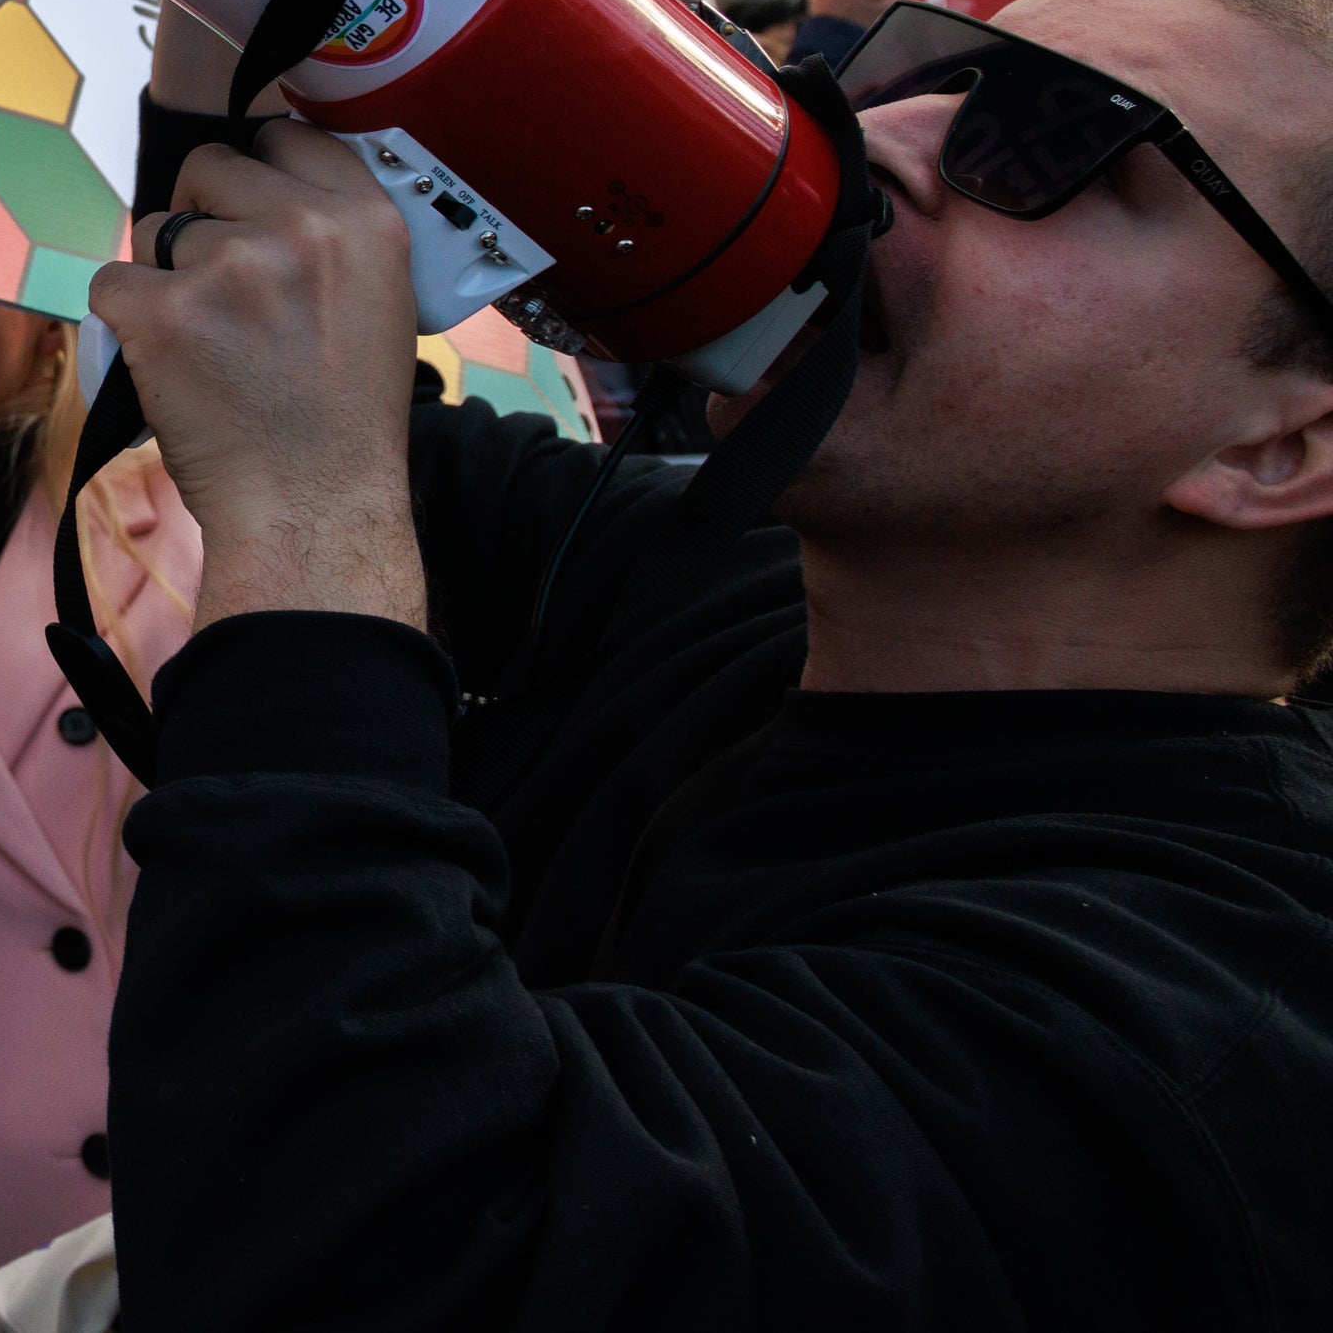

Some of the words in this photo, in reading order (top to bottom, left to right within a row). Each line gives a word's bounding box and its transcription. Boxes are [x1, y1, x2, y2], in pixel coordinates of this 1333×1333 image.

[346, 23, 376, 50] GAY
[431, 166, 456, 189] SIREN
[458, 190, 476, 206] OFF
[480, 209, 503, 231] TALK
